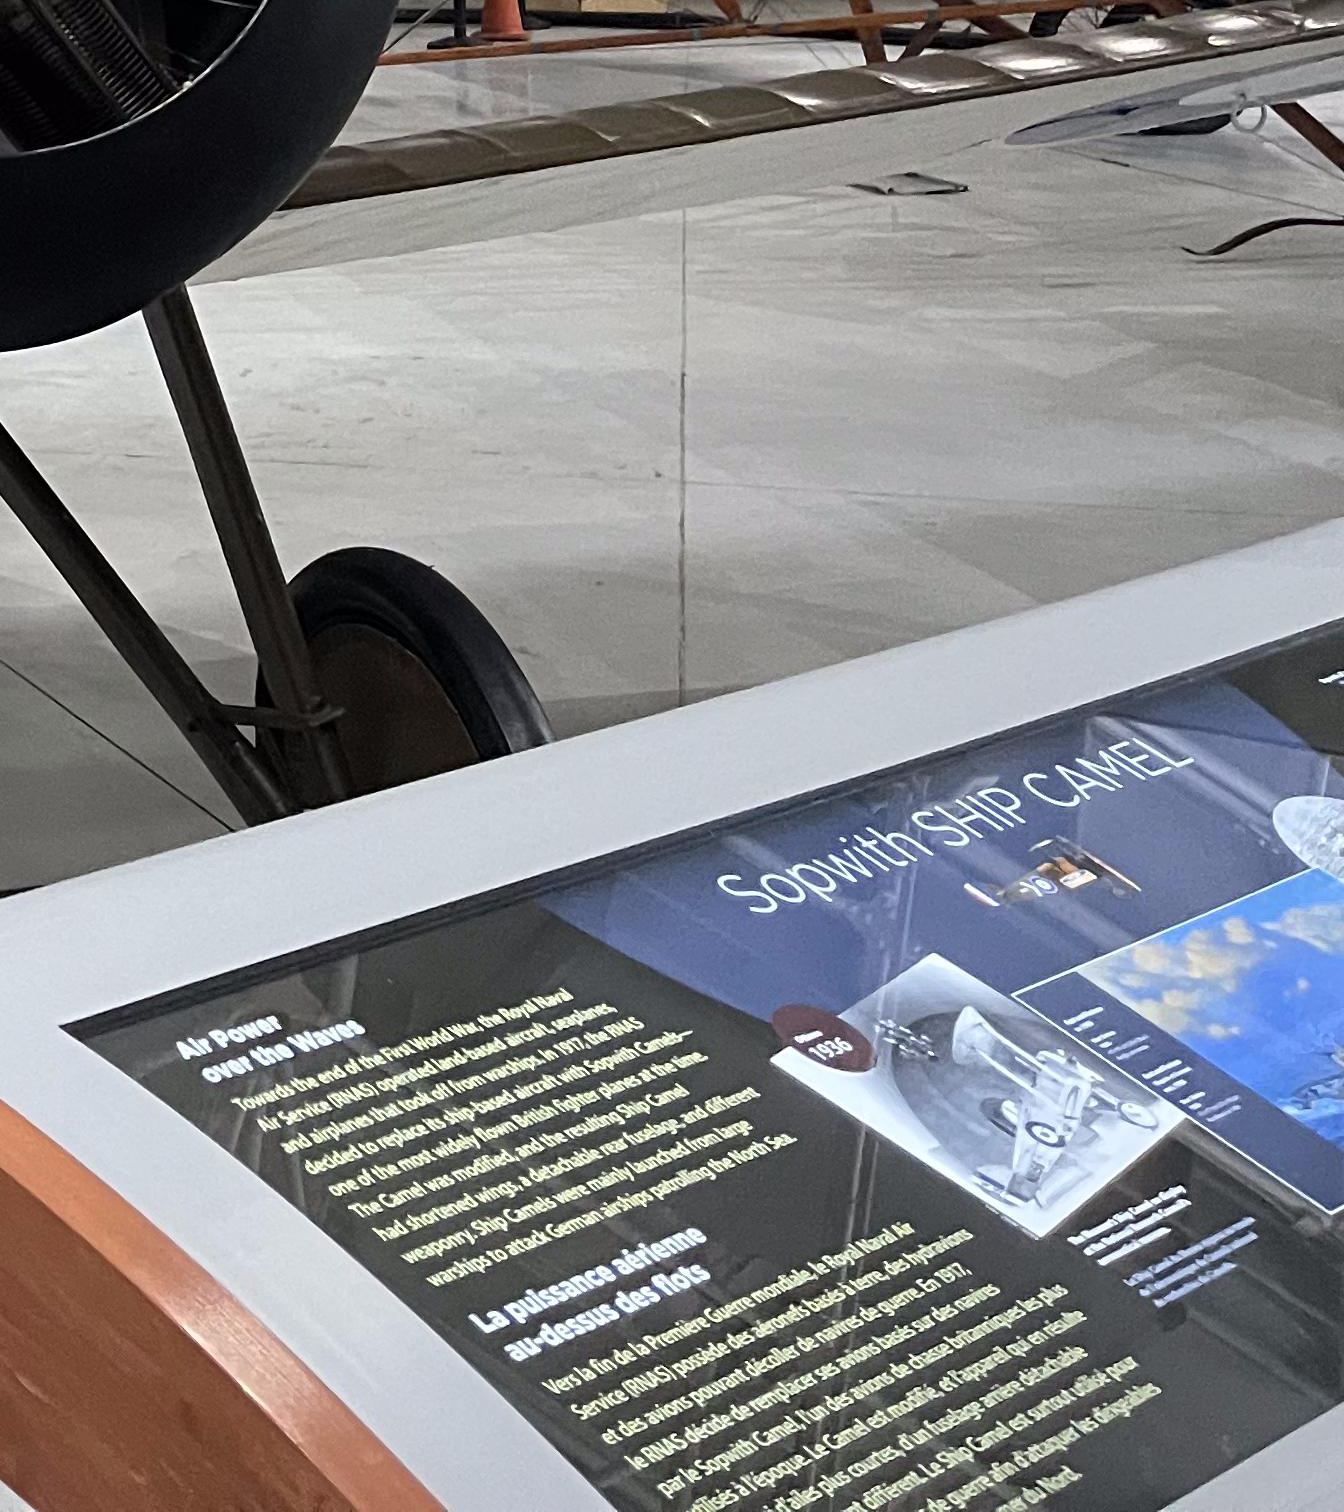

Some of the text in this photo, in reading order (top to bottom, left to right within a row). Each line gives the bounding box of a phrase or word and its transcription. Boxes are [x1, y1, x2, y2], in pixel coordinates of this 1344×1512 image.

[716, 737, 1195, 915] Sopwith SHIP CAMEL
[176, 1016, 282, 1060] Air Power
[202, 1020, 365, 1083] over the Waves
[230, 1084, 295, 1112] Towards
[290, 1077, 320, 1091] the
[318, 1065, 347, 1084] end
[344, 1058, 362, 1074] of
[358, 1055, 387, 1069] the
[379, 1043, 417, 1061] First
[406, 1027, 454, 1050] World
[477, 1014, 505, 1028] the
[498, 999, 540, 1020] Royal
[530, 987, 574, 1009] Naval
[256, 1115, 281, 1132] Air
[277, 1101, 332, 1125] Service
[327, 1082, 379, 1108] (RNAS)
[376, 1061, 439, 1092] operated
[430, 1037, 508, 1071] land-based
[281, 1133, 312, 1154] and
[309, 1115, 374, 1143] airplanes
[368, 1103, 404, 1121] that
[397, 1091, 436, 1111] took
[430, 1083, 454, 1100] off
[447, 1075, 487, 1093] from
[538, 1049, 559, 1061] In
[583, 1031, 611, 1045] the
[604, 1017, 644, 1038] RNAS
[808, 1036, 853, 1061] 1936
[305, 1144, 363, 1174] decided
[358, 1142, 379, 1154] to
[376, 1125, 430, 1149] replace
[422, 1118, 446, 1131] its
[444, 1089, 517, 1125] ship-based
[513, 1074, 562, 1099] aircraft
[557, 1065, 590, 1082] with
[583, 1047, 640, 1073] Sopwith
[328, 1052, 708, 1196] one of the most widely flown British fighter planes at the time.
[348, 1083, 690, 1218] The Camel was modified, and the resulting Ship Camel
[372, 1219, 409, 1241] had
[406, 1193, 478, 1230] shortened
[474, 1181, 524, 1203] wings,
[518, 1176, 532, 1186] a
[528, 1148, 604, 1182] detachable
[599, 1138, 628, 1155] rear
[680, 1105, 709, 1124] and
[705, 1087, 761, 1114] different
[400, 1121, 753, 1263] weaponry. Ship Camels were mainly launched from large
[426, 1134, 798, 1286] warships to attack German airships patrolling the North Sea.
[468, 1228, 707, 1333] La puissance aérienne
[504, 1265, 710, 1361] au-dessus des flots
[541, 1374, 582, 1394] Vers
[573, 1367, 597, 1381] la
[589, 1359, 617, 1374] fin
[613, 1349, 637, 1365] de
[627, 1343, 651, 1357] la
[642, 1317, 710, 1350] Première
[704, 1297, 756, 1322] Guerre
[807, 1262, 830, 1275] le
[822, 1243, 864, 1270] Royal
[855, 1228, 898, 1253] Naval
[891, 1222, 915, 1238] Air
[571, 1390, 629, 1420] Service
[621, 1365, 677, 1398] (RNAS)
[671, 1342, 731, 1378] possède
[727, 1331, 755, 1349] des
[837, 1282, 856, 1295] à
[883, 1259, 910, 1275] des
[601, 1429, 623, 1444] et
[618, 1418, 648, 1436] des
[644, 1396, 693, 1424] avions
[688, 1369, 750, 1407] pouvant
[745, 1345, 800, 1377] décoller
[796, 1336, 820, 1352] de
[815, 1315, 864, 1346] navires
[860, 1307, 882, 1321] de
[916, 1279, 941, 1292] En
[624, 1456, 649, 1470] le
[640, 1433, 688, 1463] RNAS
[684, 1414, 735, 1443] décide
[730, 1404, 754, 1421] de
[747, 1373, 818, 1412] remplacer
[814, 1363, 841, 1380] ses
[836, 1343, 881, 1369] avions
[911, 1315, 935, 1332] sur
[931, 1304, 959, 1321] des
[954, 1284, 1000, 1311] navires
